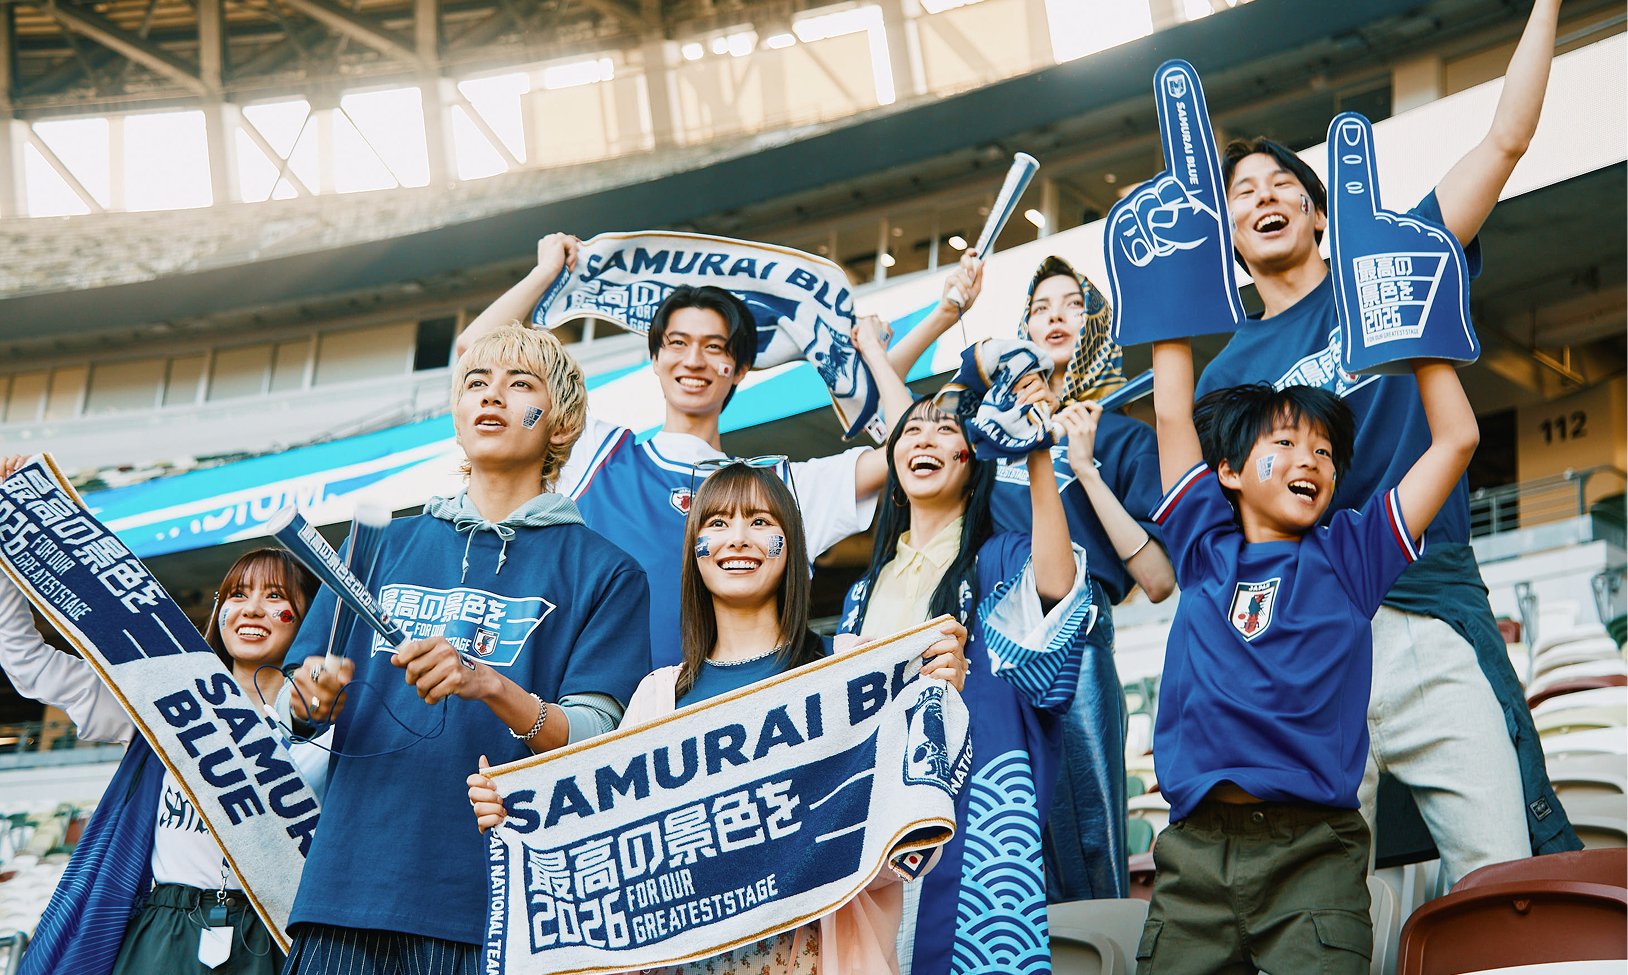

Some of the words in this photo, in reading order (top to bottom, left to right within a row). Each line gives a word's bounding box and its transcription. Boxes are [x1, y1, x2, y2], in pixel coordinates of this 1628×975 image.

[1176, 102, 1194, 155] SAMURAI
[1186, 156, 1199, 185] BLUE
[579, 248, 777, 282] SAMURAI
[786, 268, 853, 326] BLU
[1358, 257, 1414, 283] 最高の
[1361, 281, 1414, 308] 景色を
[1365, 306, 1402, 334] 2026
[1541, 411, 1587, 446] 112
[30, 533, 56, 561] FOR
[50, 550, 76, 576] OUR
[382, 588, 507, 630] 最高の景色を
[414, 622, 431, 637] FOR
[430, 623, 447, 638] OUR
[153, 689, 266, 826] BLUE
[503, 692, 825, 834] SAMURAI
[847, 660, 924, 727] BL
[950, 736, 974, 796] NATIO
[528, 781, 803, 902] 最高の景色を
[488, 865, 507, 940] NATIONAL
[626, 879, 660, 913] FOR
[662, 868, 695, 901] OUR
[530, 889, 630, 950] 2026
